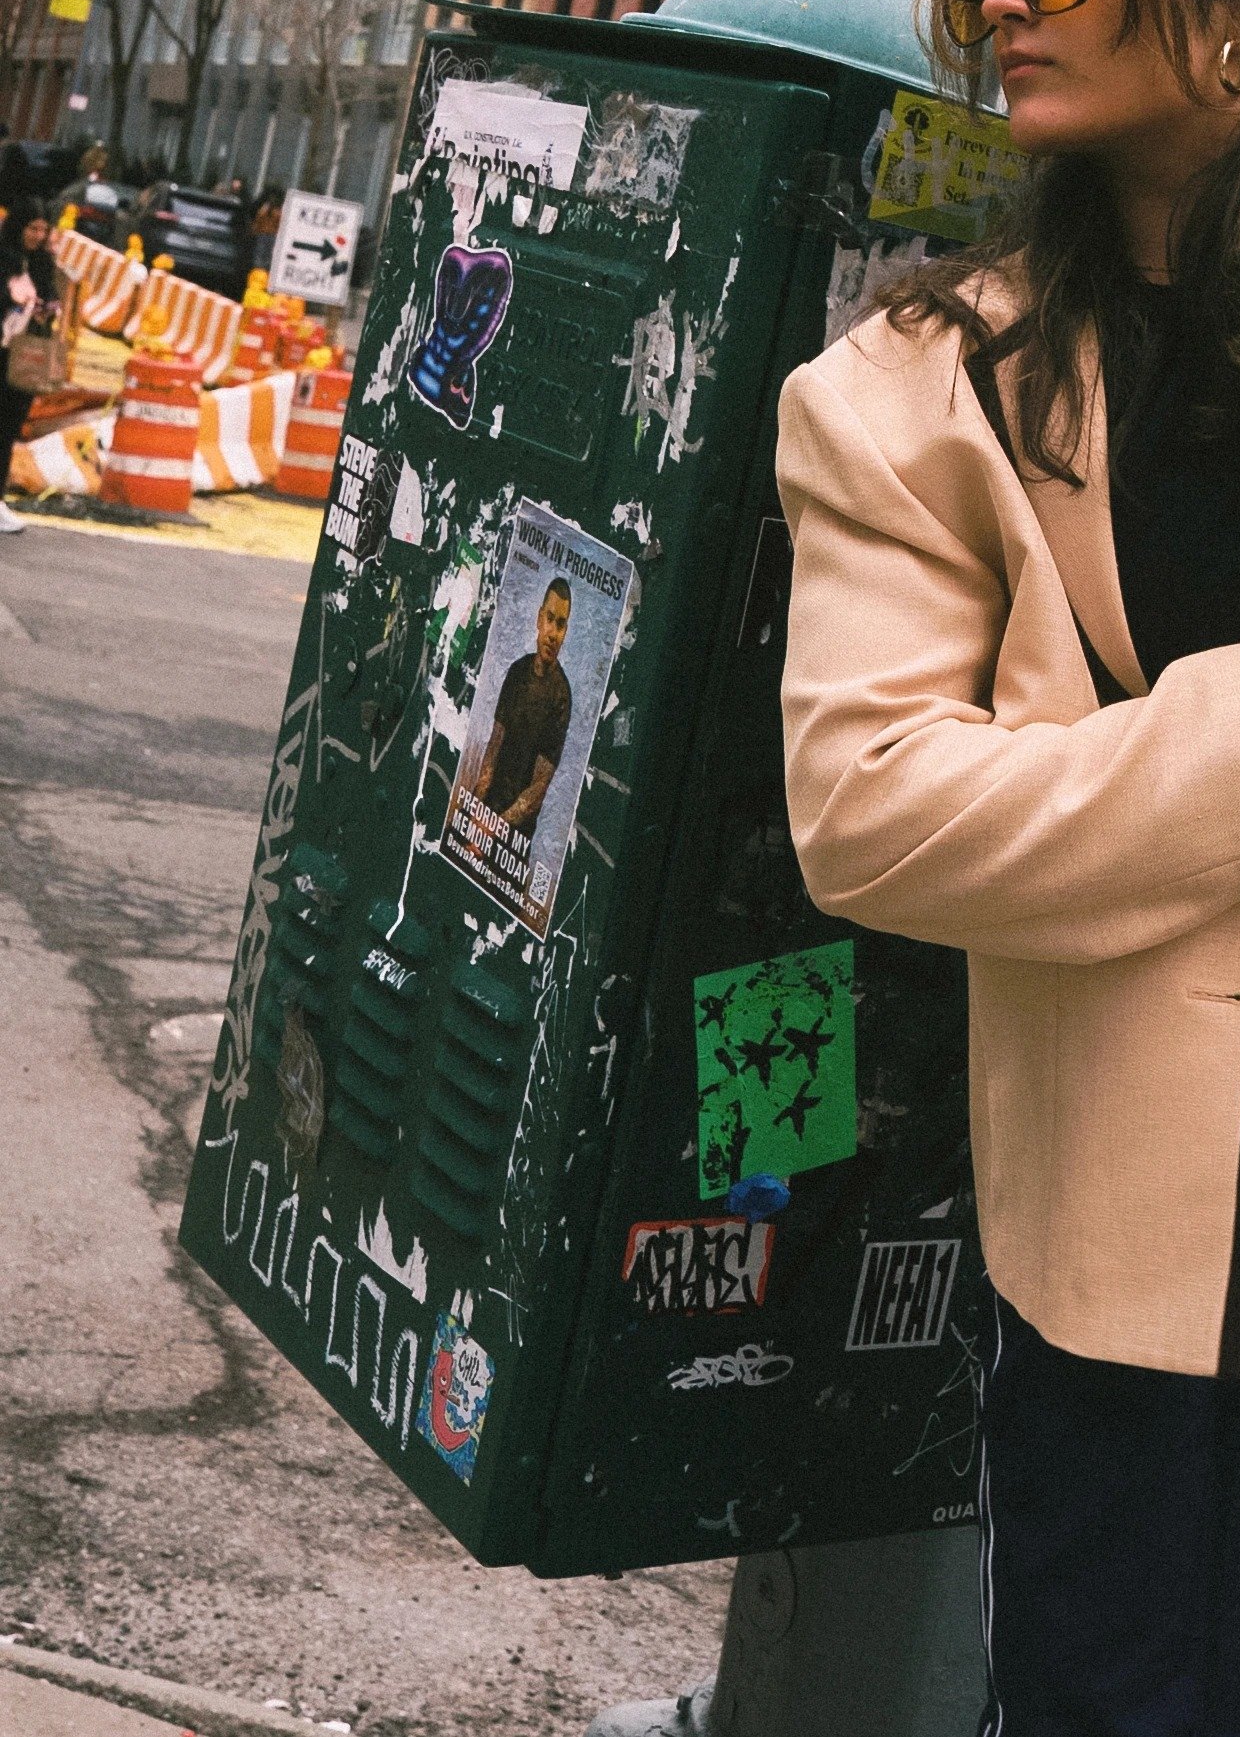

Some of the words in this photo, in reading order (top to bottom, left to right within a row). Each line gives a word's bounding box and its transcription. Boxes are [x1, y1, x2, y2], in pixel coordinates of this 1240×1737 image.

[339, 433, 378, 482] STEVE
[338, 471, 364, 513] THE
[325, 503, 360, 551] BUM
[518, 519, 551, 557] WORK
[549, 540, 565, 565] IN
[564, 548, 624, 601] PROGRESS
[451, 809, 493, 857] MEMOIR
[494, 843, 530, 886] TODAY
[456, 785, 510, 844] PREORDER
[511, 829, 530, 857] MY
